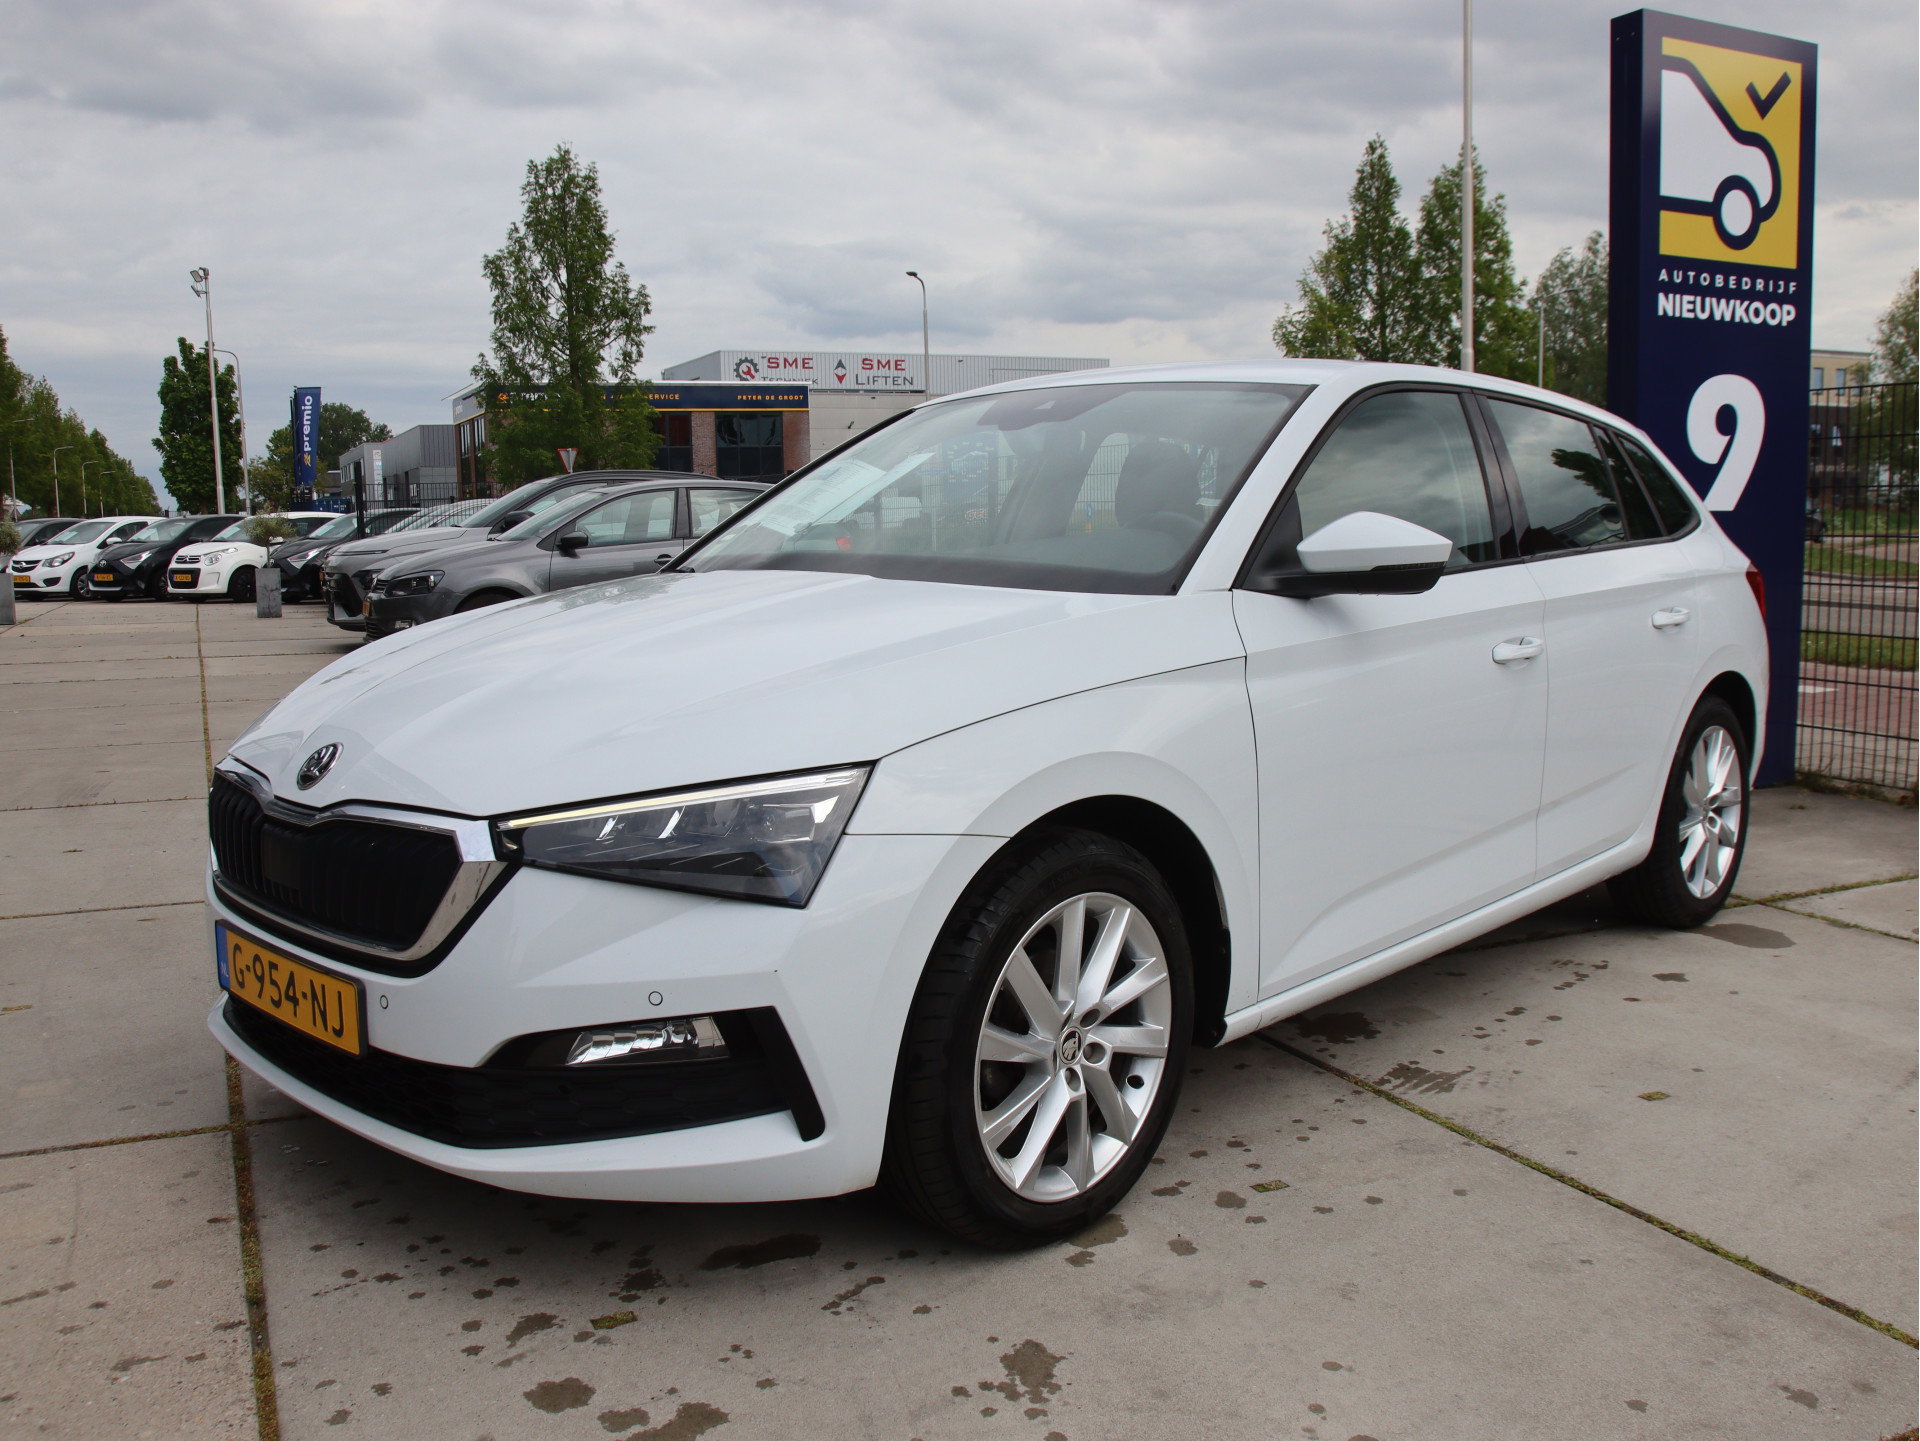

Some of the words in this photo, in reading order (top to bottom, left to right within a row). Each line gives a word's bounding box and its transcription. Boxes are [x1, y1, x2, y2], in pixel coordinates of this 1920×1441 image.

[1658, 268, 1797, 295] AUTOBEDRIJF
[1657, 292, 1796, 327] NIEUWKOOP
[767, 356, 814, 370] SME
[861, 357, 906, 371] SME
[855, 373, 914, 386] LIFTEN
[302, 395, 313, 452] premio
[1686, 373, 1766, 512] 9
[232, 943, 345, 1038] G-954-NJ
